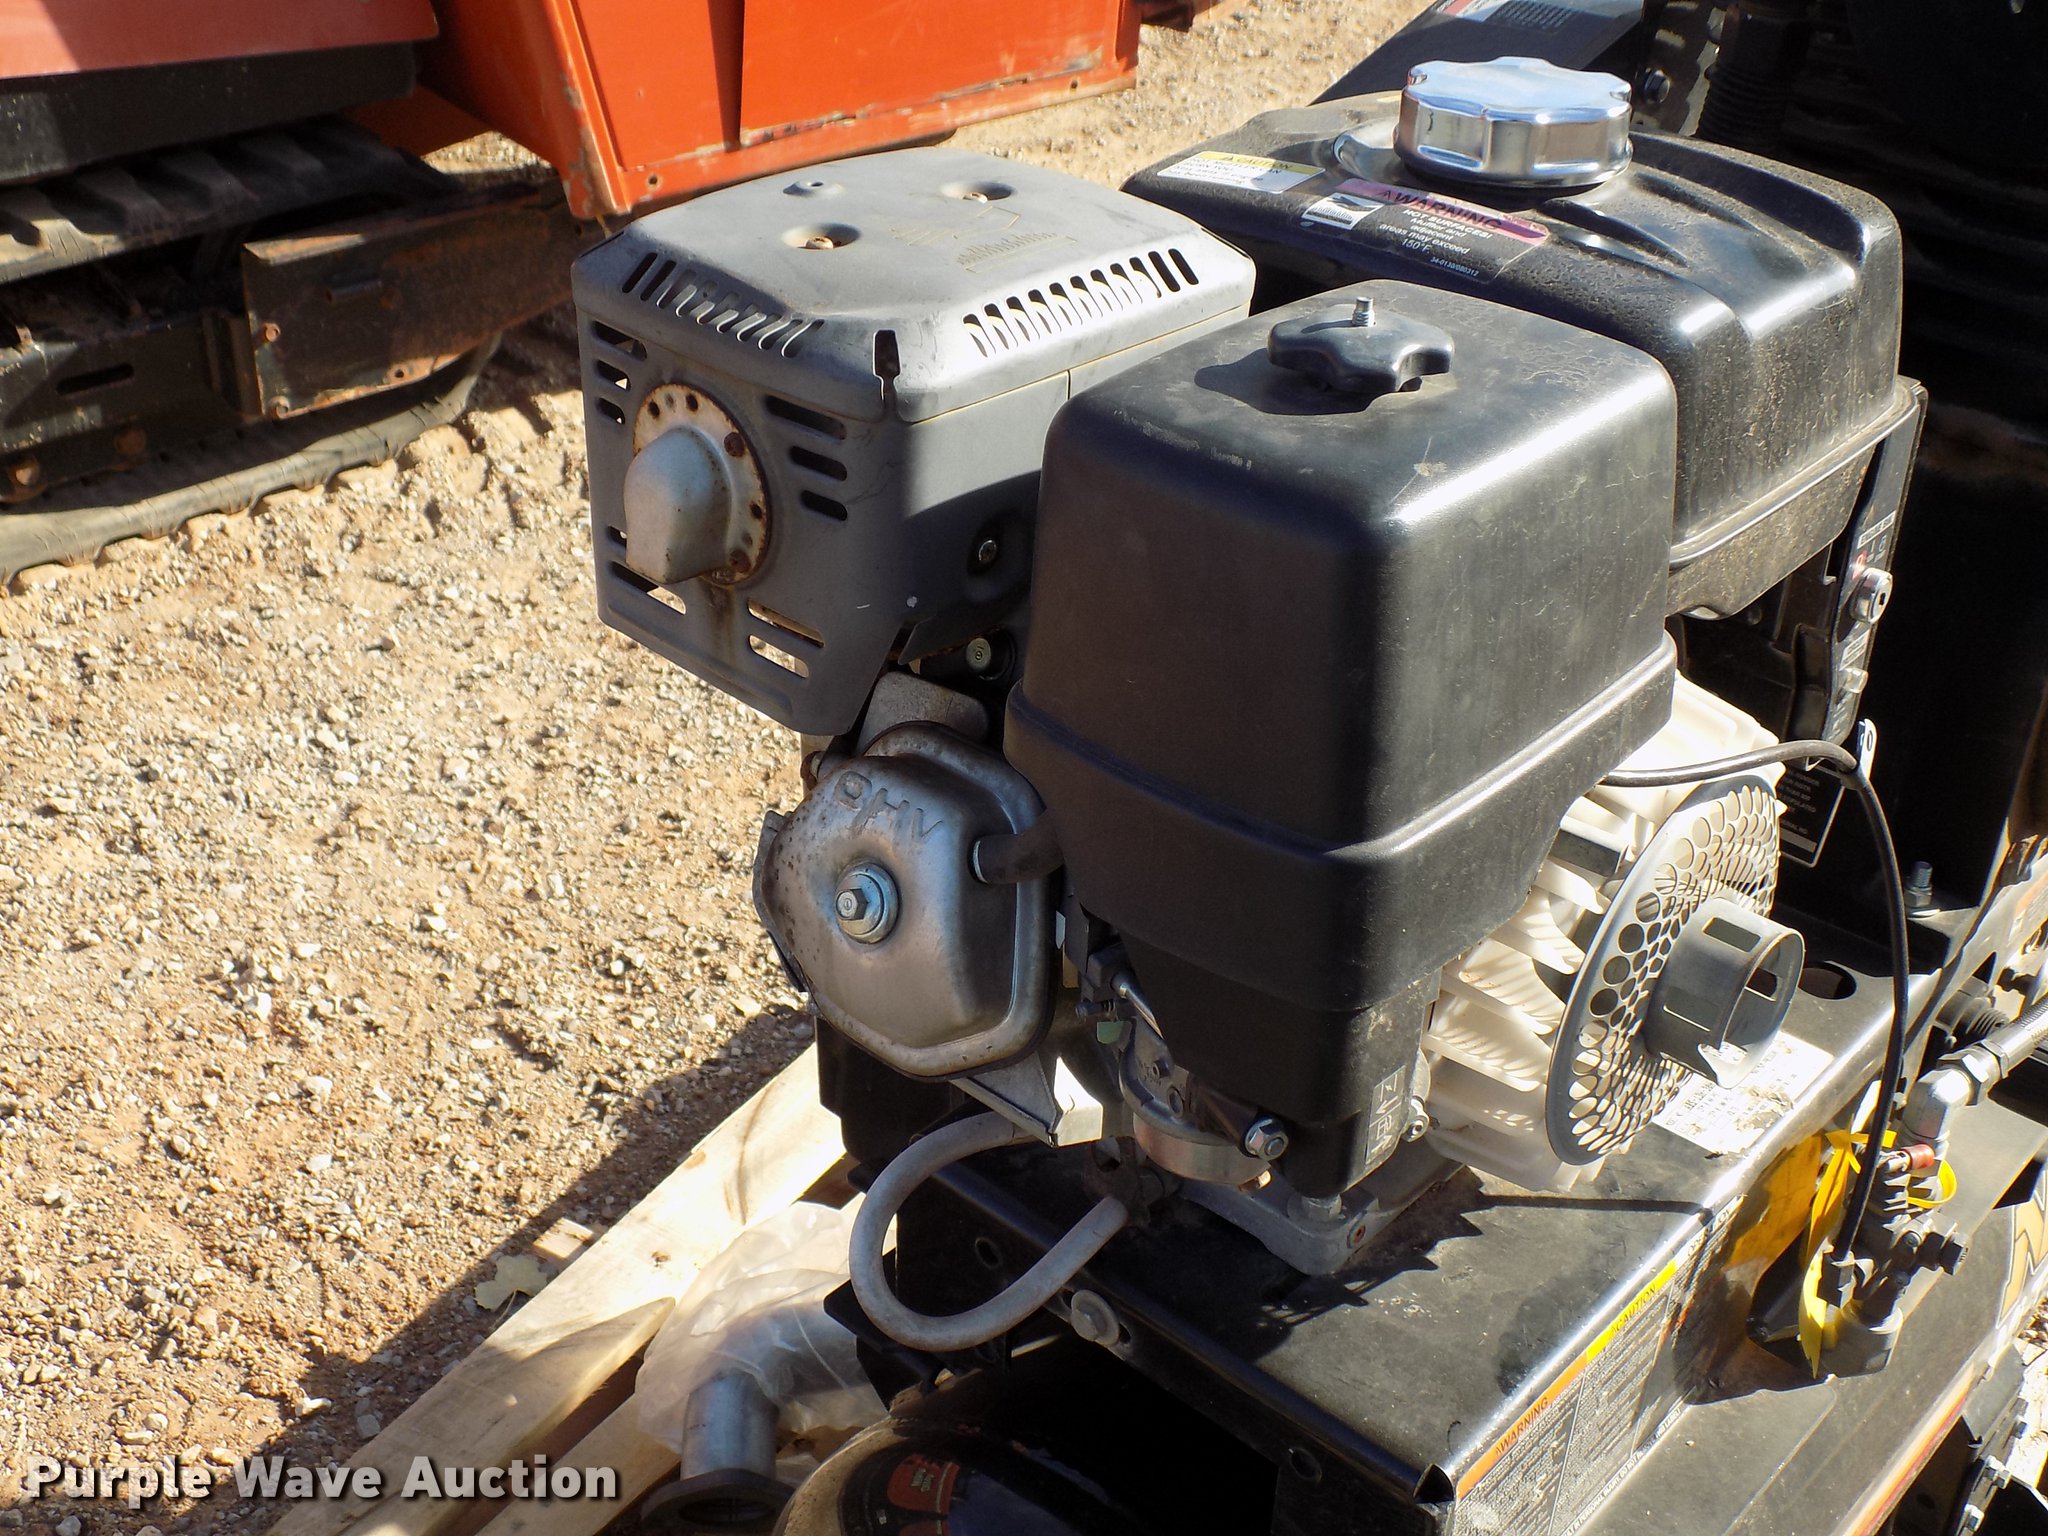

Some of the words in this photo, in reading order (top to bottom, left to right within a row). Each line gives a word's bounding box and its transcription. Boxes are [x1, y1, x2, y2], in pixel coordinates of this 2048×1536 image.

[1394, 192, 1502, 229] WARNING
[1403, 209, 1429, 219] HOT
[1430, 216, 1493, 239] SURFACES!
[1379, 223, 1408, 235] areas
[1408, 231, 1432, 242] may
[1432, 239, 1471, 254] exceed
[1410, 218, 1445, 231] Muffler
[1445, 228, 1467, 238] and
[1410, 225, 1454, 240] adjacent
[833, 770, 945, 850] OHV
[1500, 1397, 1548, 1452] WARNING
